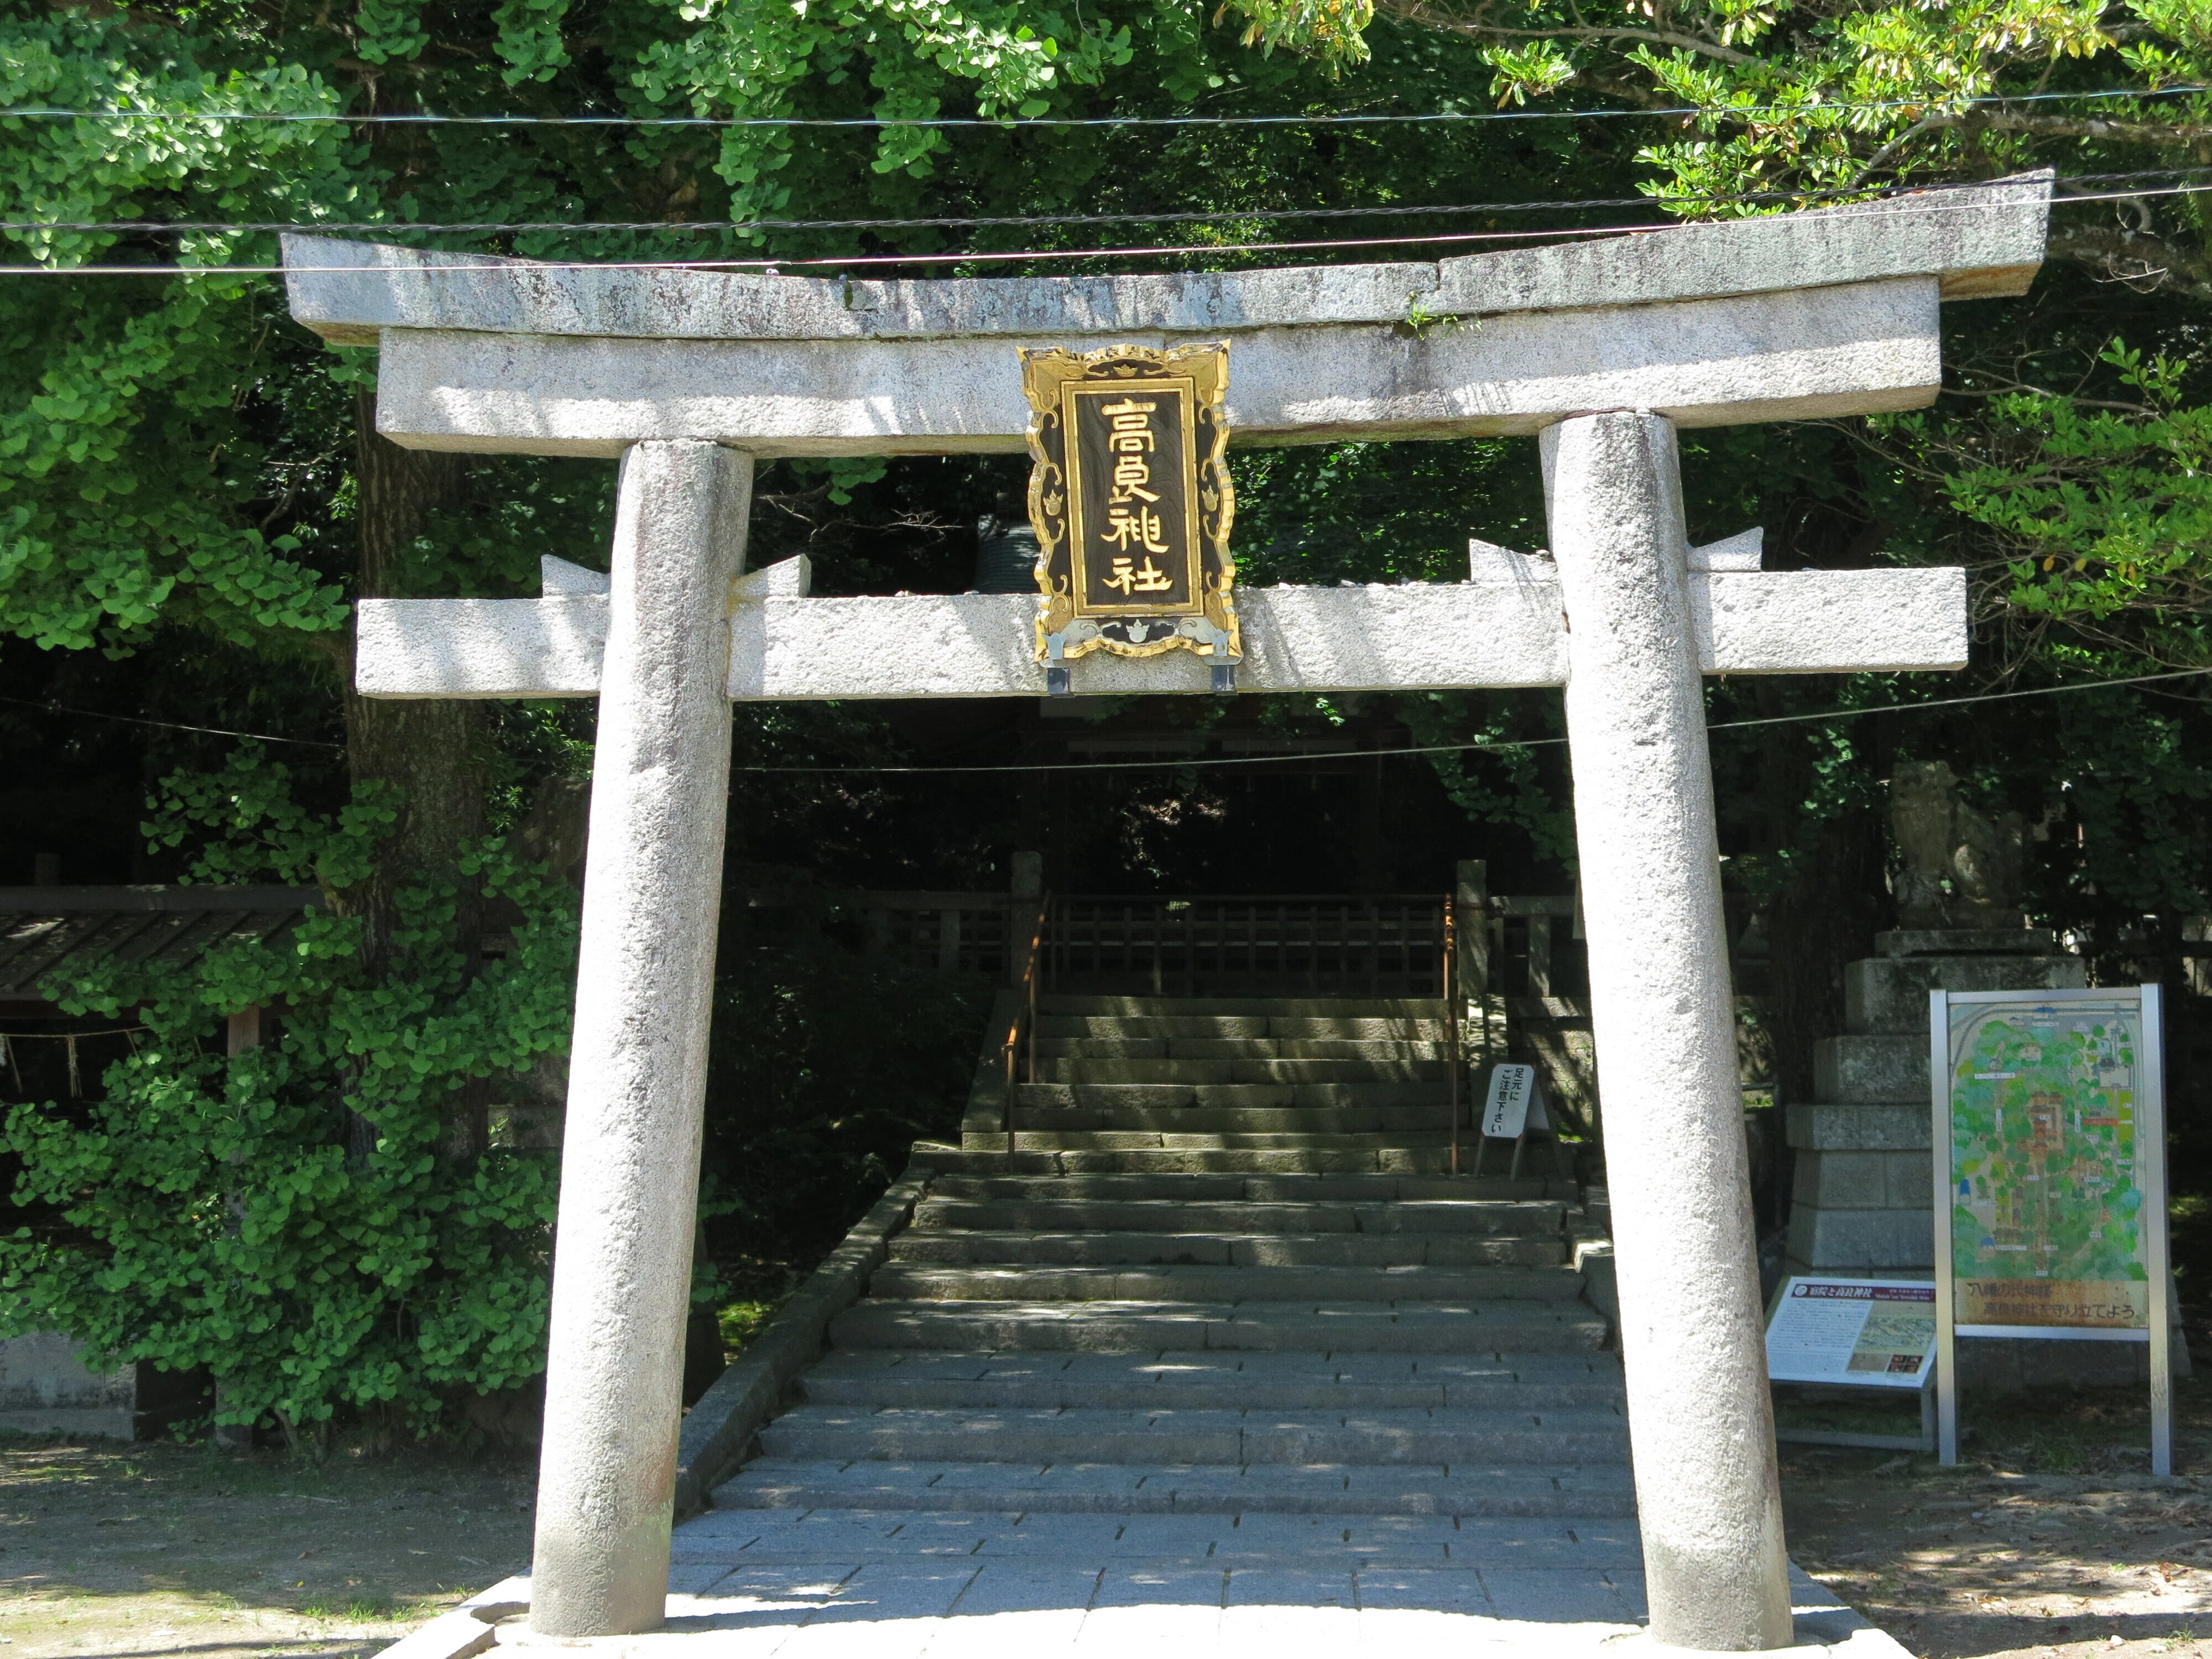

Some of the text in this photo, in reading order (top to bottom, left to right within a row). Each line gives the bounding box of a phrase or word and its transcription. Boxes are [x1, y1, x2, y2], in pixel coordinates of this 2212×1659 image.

[1101, 398, 1173, 596] 高良神社
[1491, 1069, 1513, 1133] ご注意下さい
[1509, 1067, 1524, 1101] 足元に
